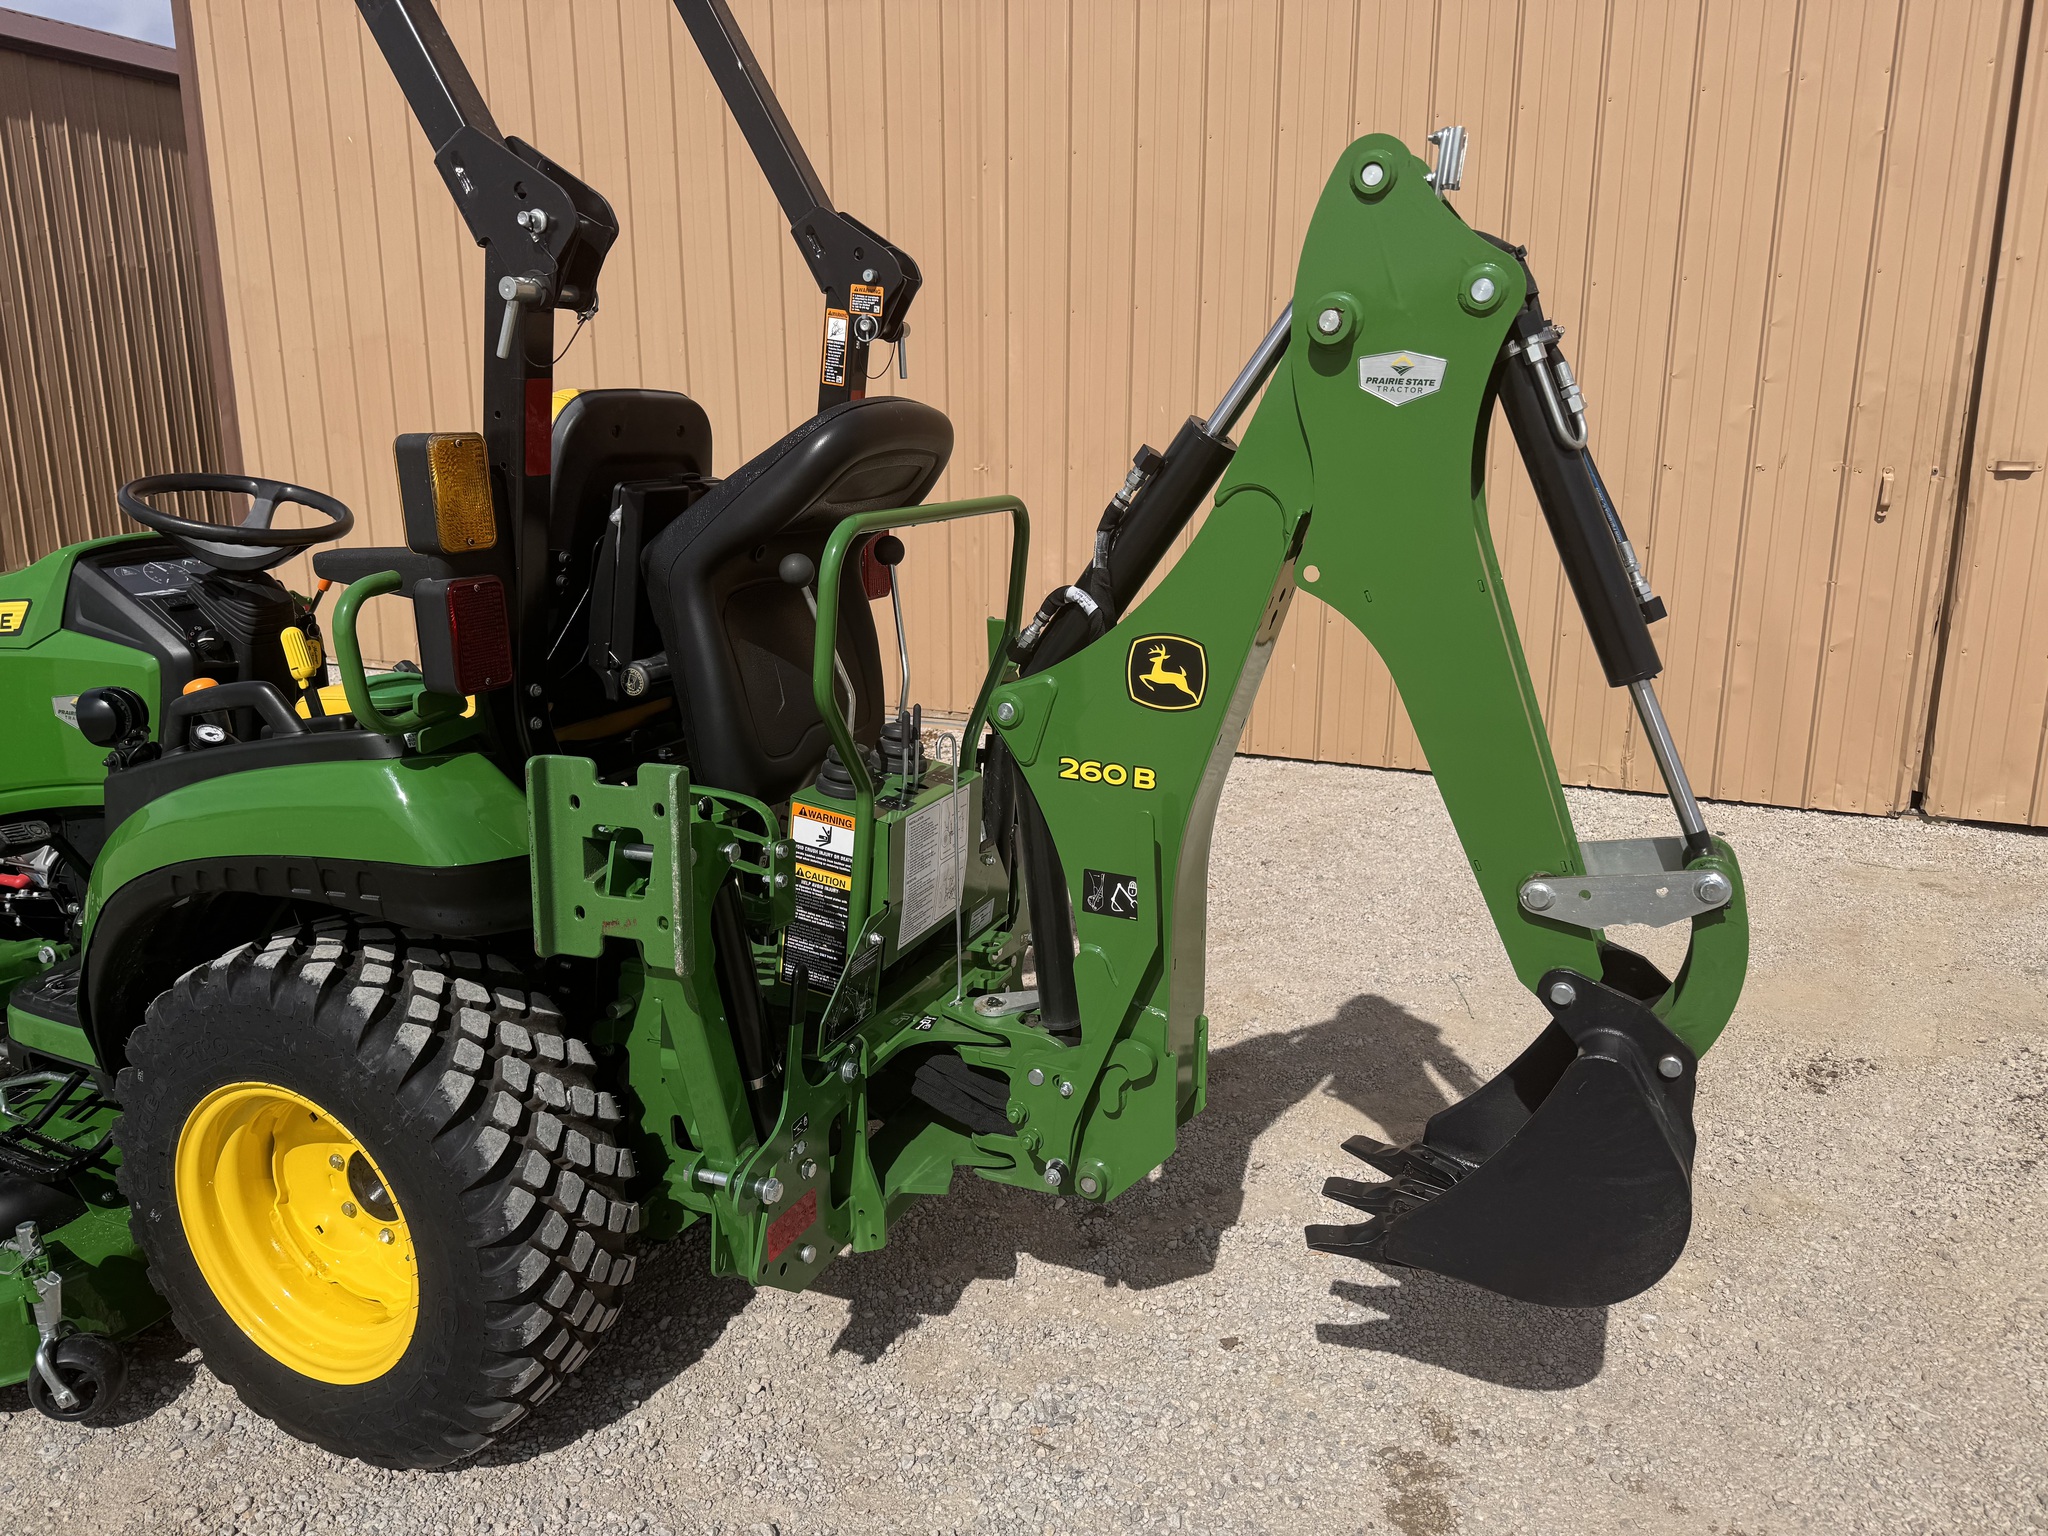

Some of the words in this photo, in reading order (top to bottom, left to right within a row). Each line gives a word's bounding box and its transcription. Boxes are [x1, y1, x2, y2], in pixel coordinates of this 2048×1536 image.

[1365, 376, 1405, 386] PRAIRIE
[1405, 378, 1437, 387] STATE
[1376, 385, 1424, 394] TRACTOR
[1058, 755, 1129, 787] 260
[1131, 764, 1157, 791] B
[808, 809, 853, 829] WARNING
[805, 870, 847, 889] CAUTION
